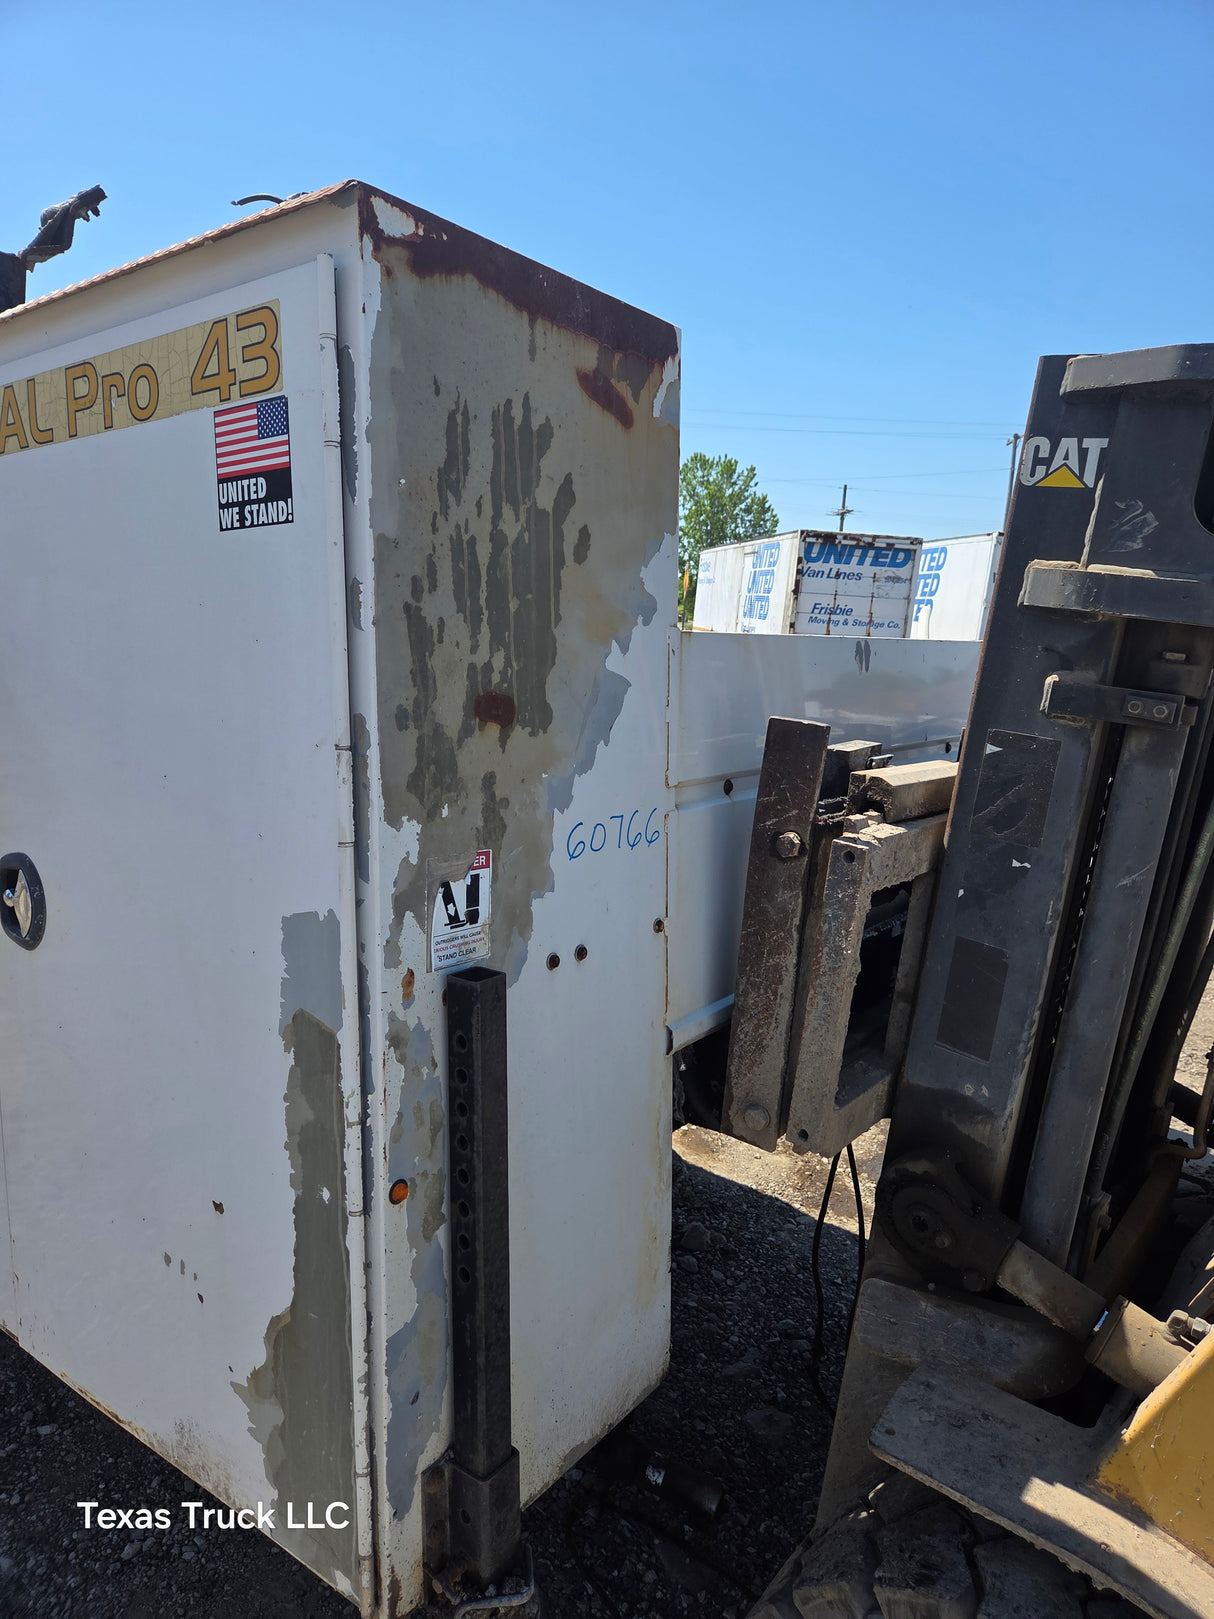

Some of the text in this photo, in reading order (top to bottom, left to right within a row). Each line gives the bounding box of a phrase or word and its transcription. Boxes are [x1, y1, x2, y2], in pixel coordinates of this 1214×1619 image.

[65, 361, 159, 438] Pro
[190, 305, 280, 402] 43
[1019, 436, 1109, 489] CAT
[219, 477, 267, 505] UNITED
[219, 498, 293, 529] WE STAND!
[752, 541, 780, 569] UNITED
[804, 541, 912, 569] UNITED
[747, 568, 775, 594] UNITED
[801, 566, 863, 581] Van Lines
[742, 595, 770, 620] UNITED
[811, 602, 854, 616] Frisbie
[807, 616, 840, 627] Moving
[842, 619, 849, 627] &
[887, 621, 901, 629] Co.
[566, 807, 660, 861] 60766
[458, 947, 477, 957] CLEAR
